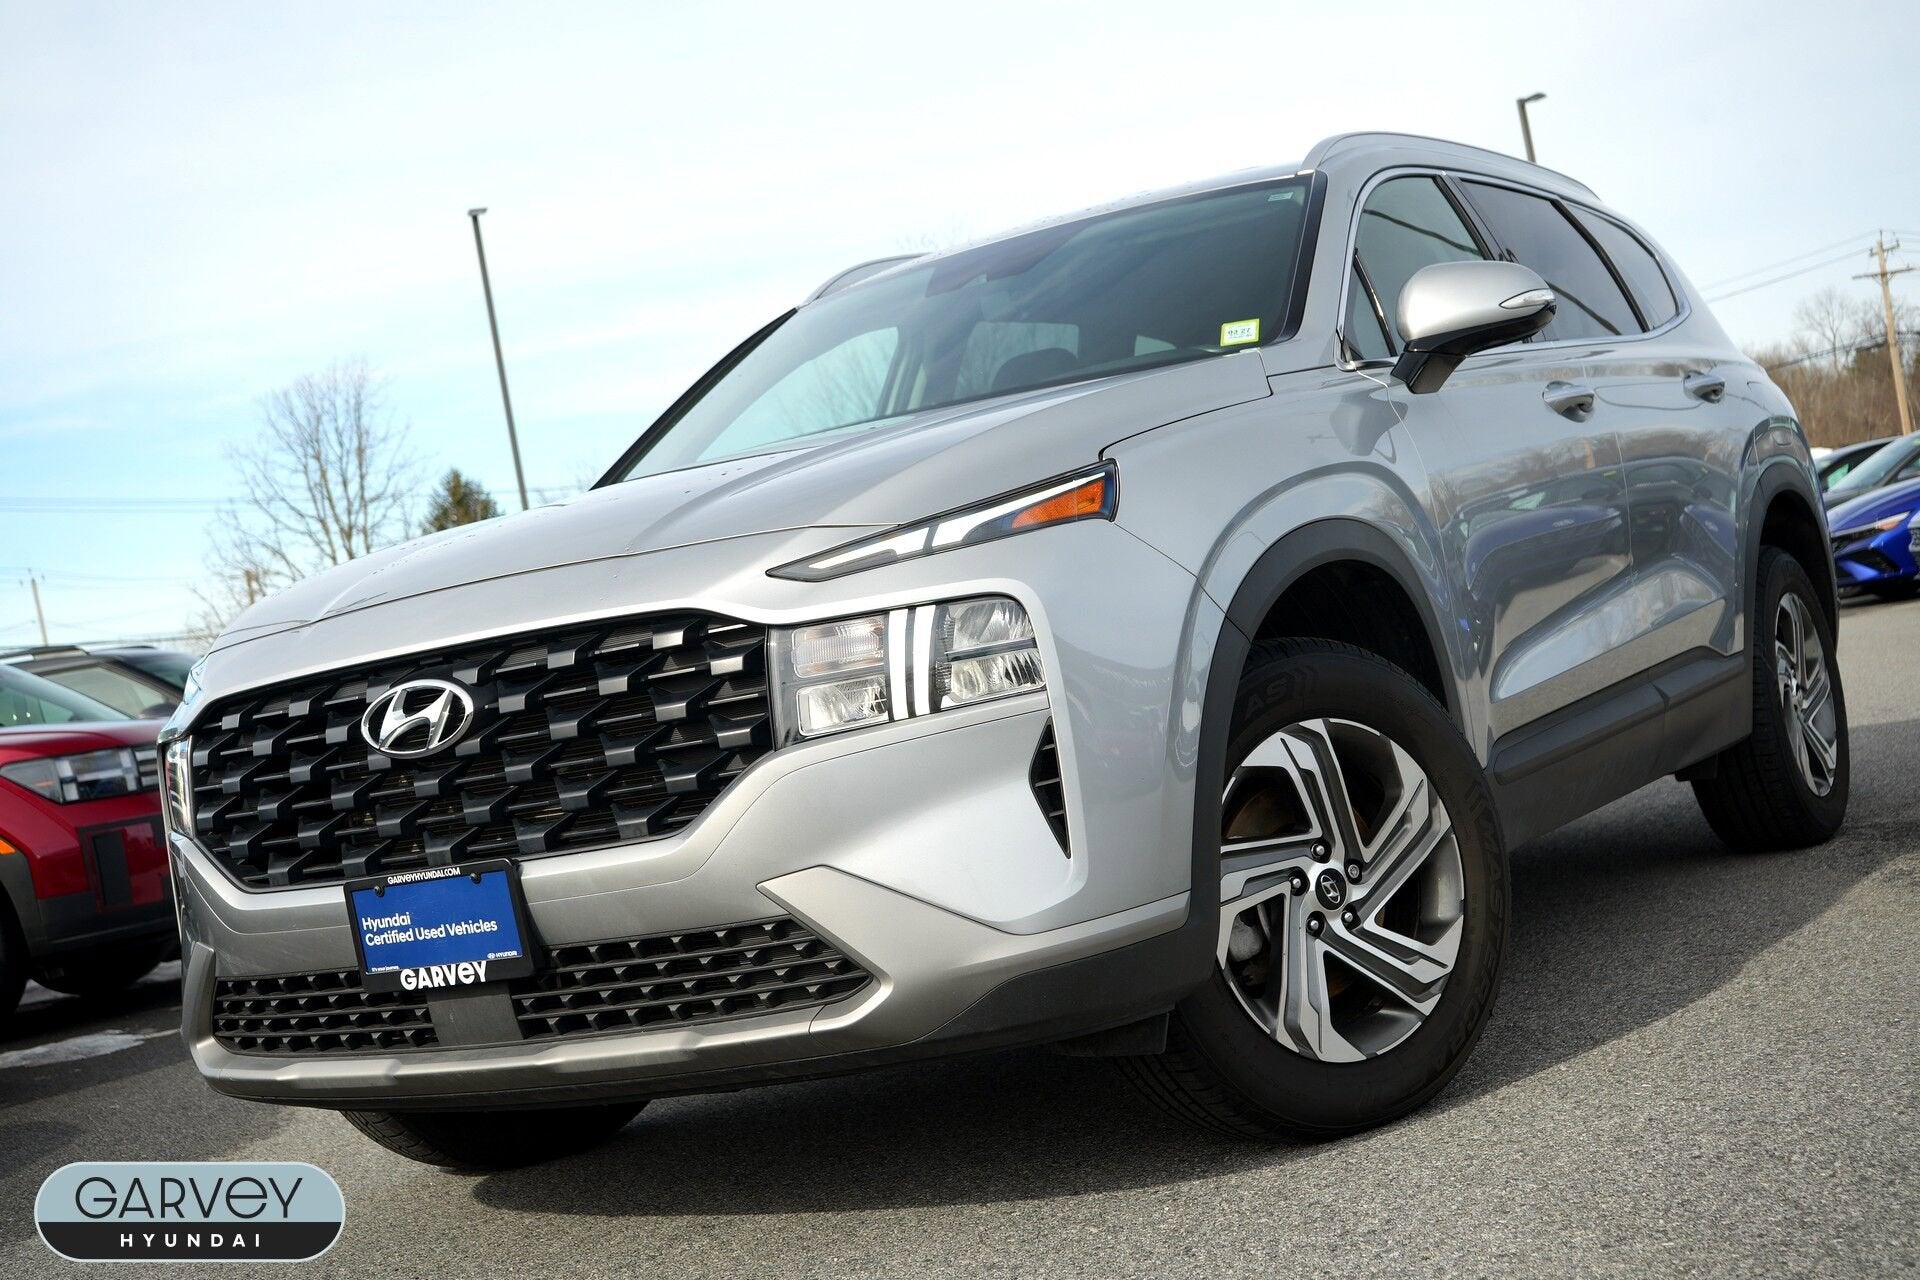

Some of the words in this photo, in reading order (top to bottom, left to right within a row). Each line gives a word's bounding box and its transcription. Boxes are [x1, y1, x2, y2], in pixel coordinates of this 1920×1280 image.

[362, 912, 411, 931] Hyundai
[365, 929, 415, 946] Certified
[415, 924, 446, 941] Used
[447, 919, 498, 937] Vehicles
